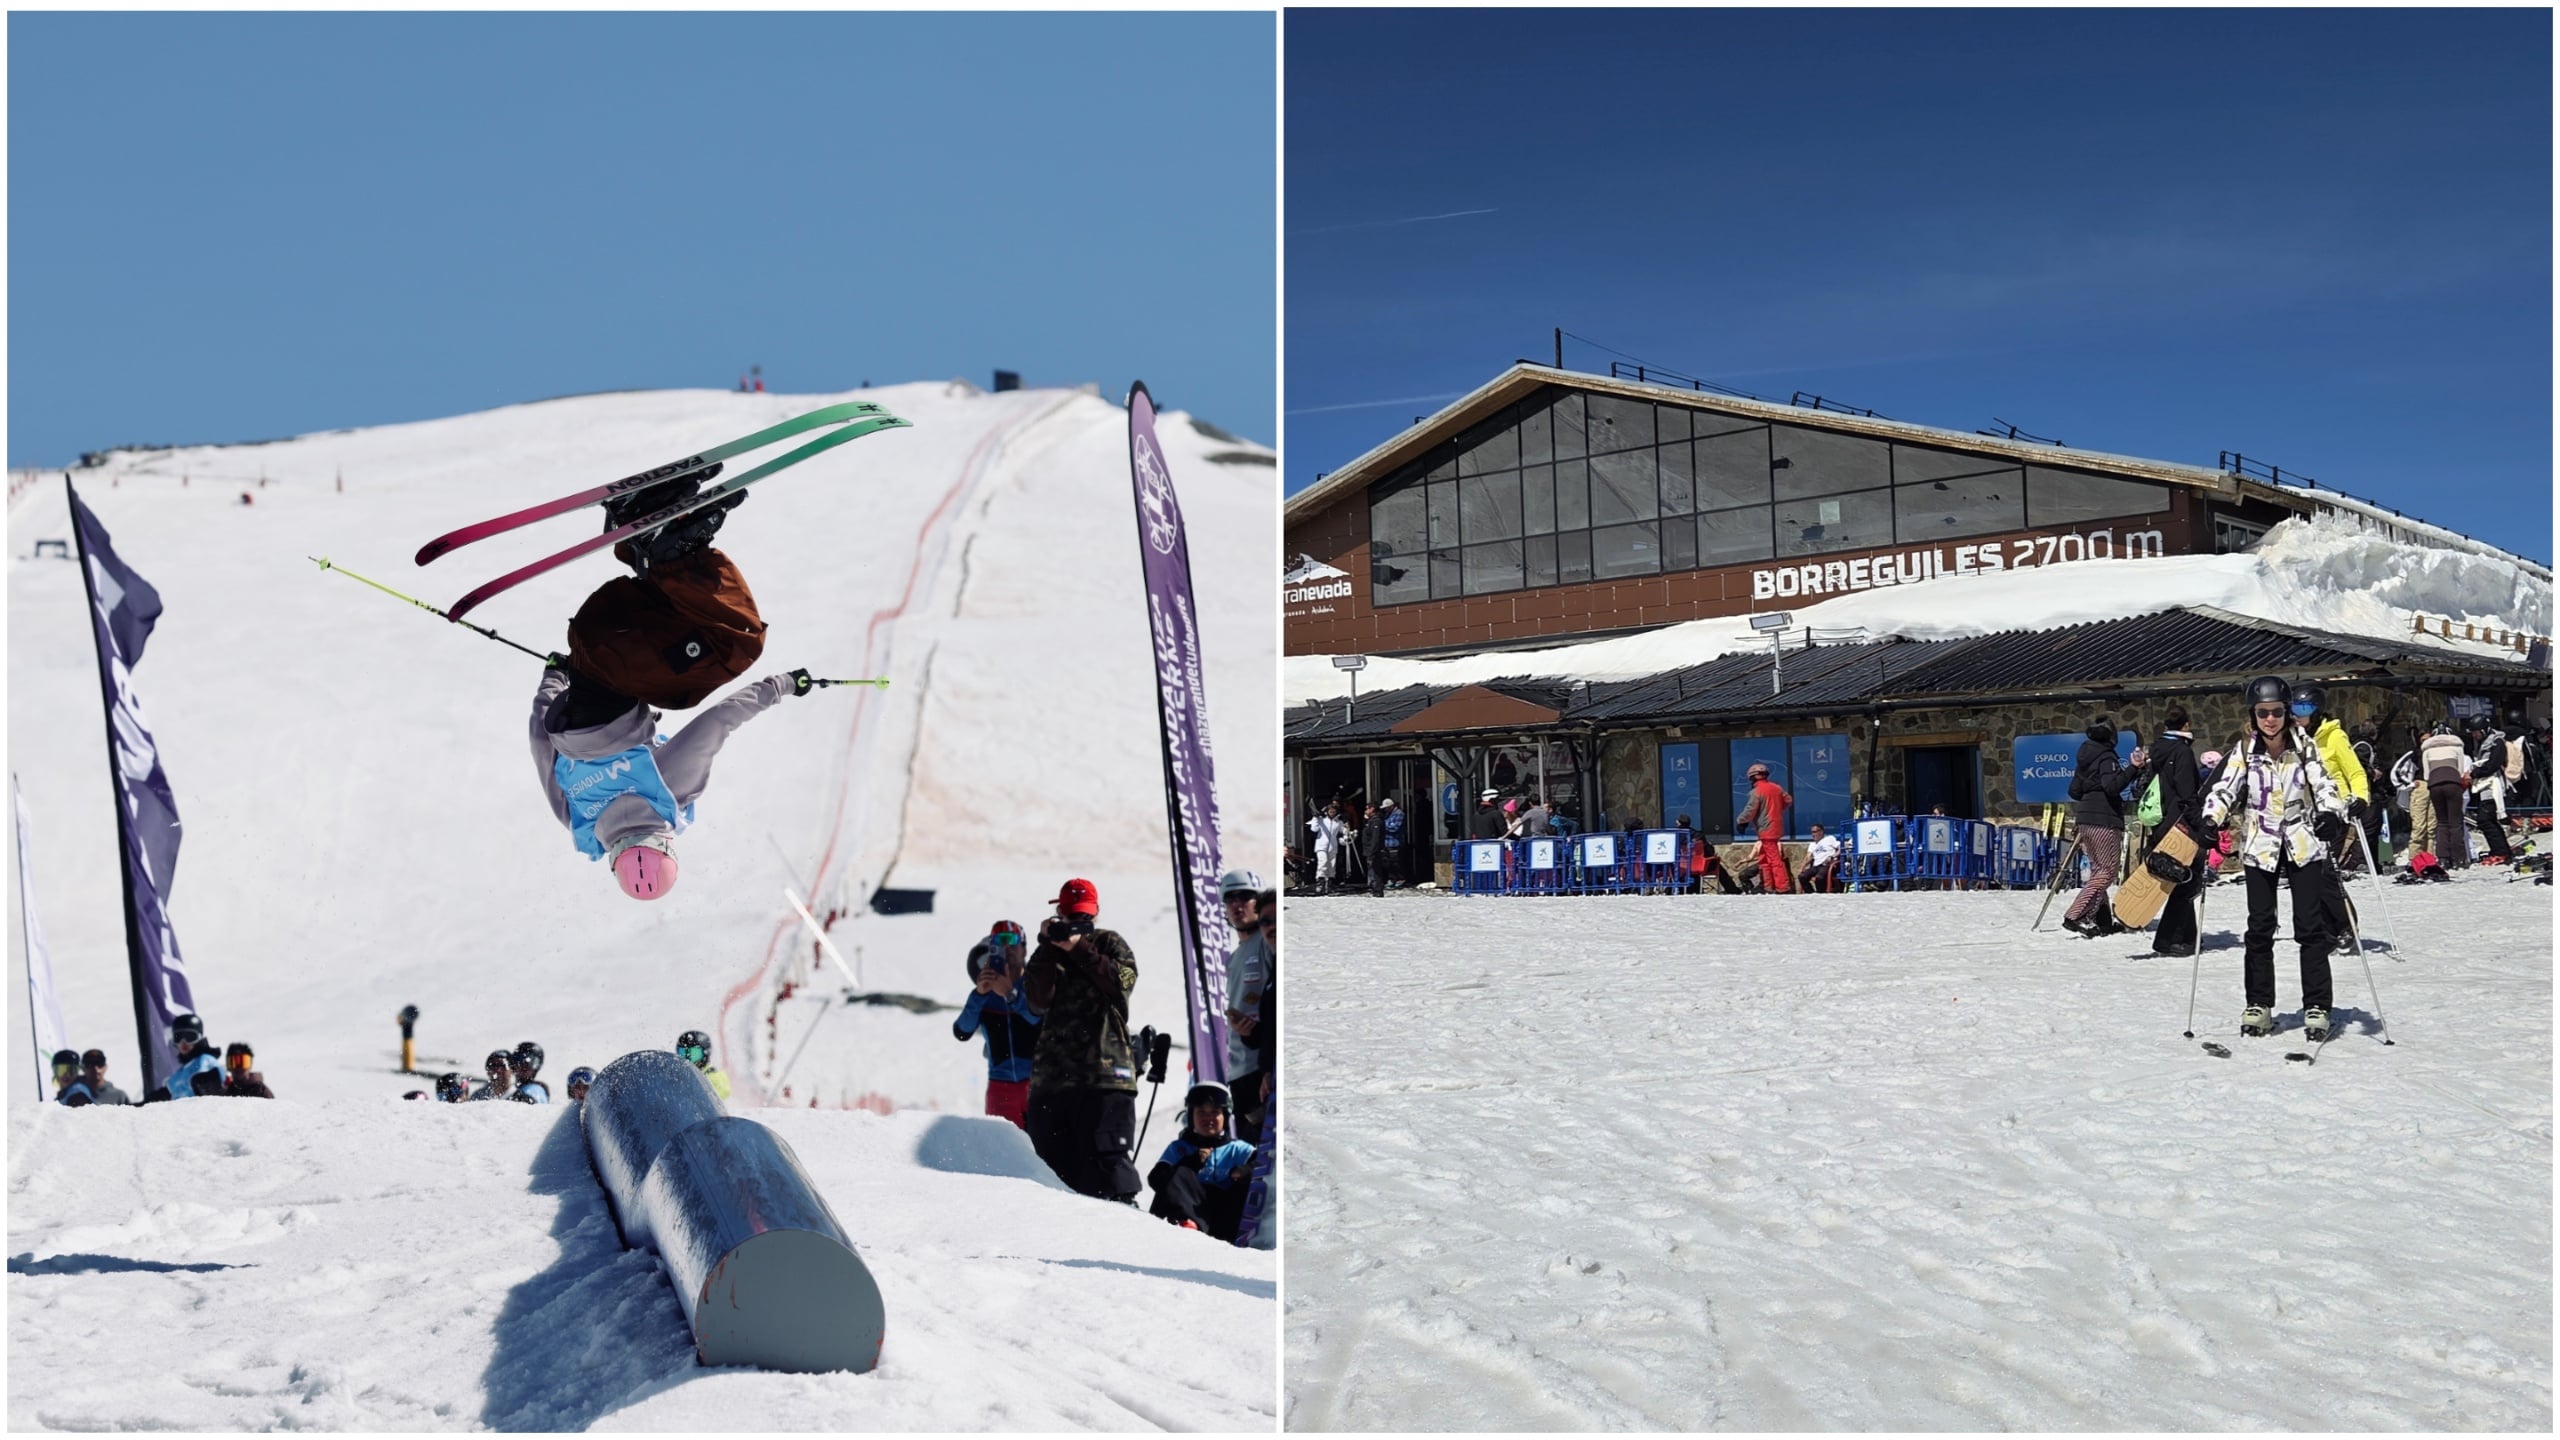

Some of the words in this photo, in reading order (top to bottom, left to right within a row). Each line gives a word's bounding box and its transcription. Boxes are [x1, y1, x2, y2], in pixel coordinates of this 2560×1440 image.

[606, 455, 705, 494] FACTION
[630, 485, 727, 530] FACTION
[1752, 543, 2003, 600] BORREGUILES
[2012, 534, 2113, 571] 2700
[2125, 529, 2164, 560] m
[1284, 579, 1352, 603] ranevada
[1152, 593, 1187, 784] ANDALUZA
[2034, 753, 2069, 763] ESPACIO
